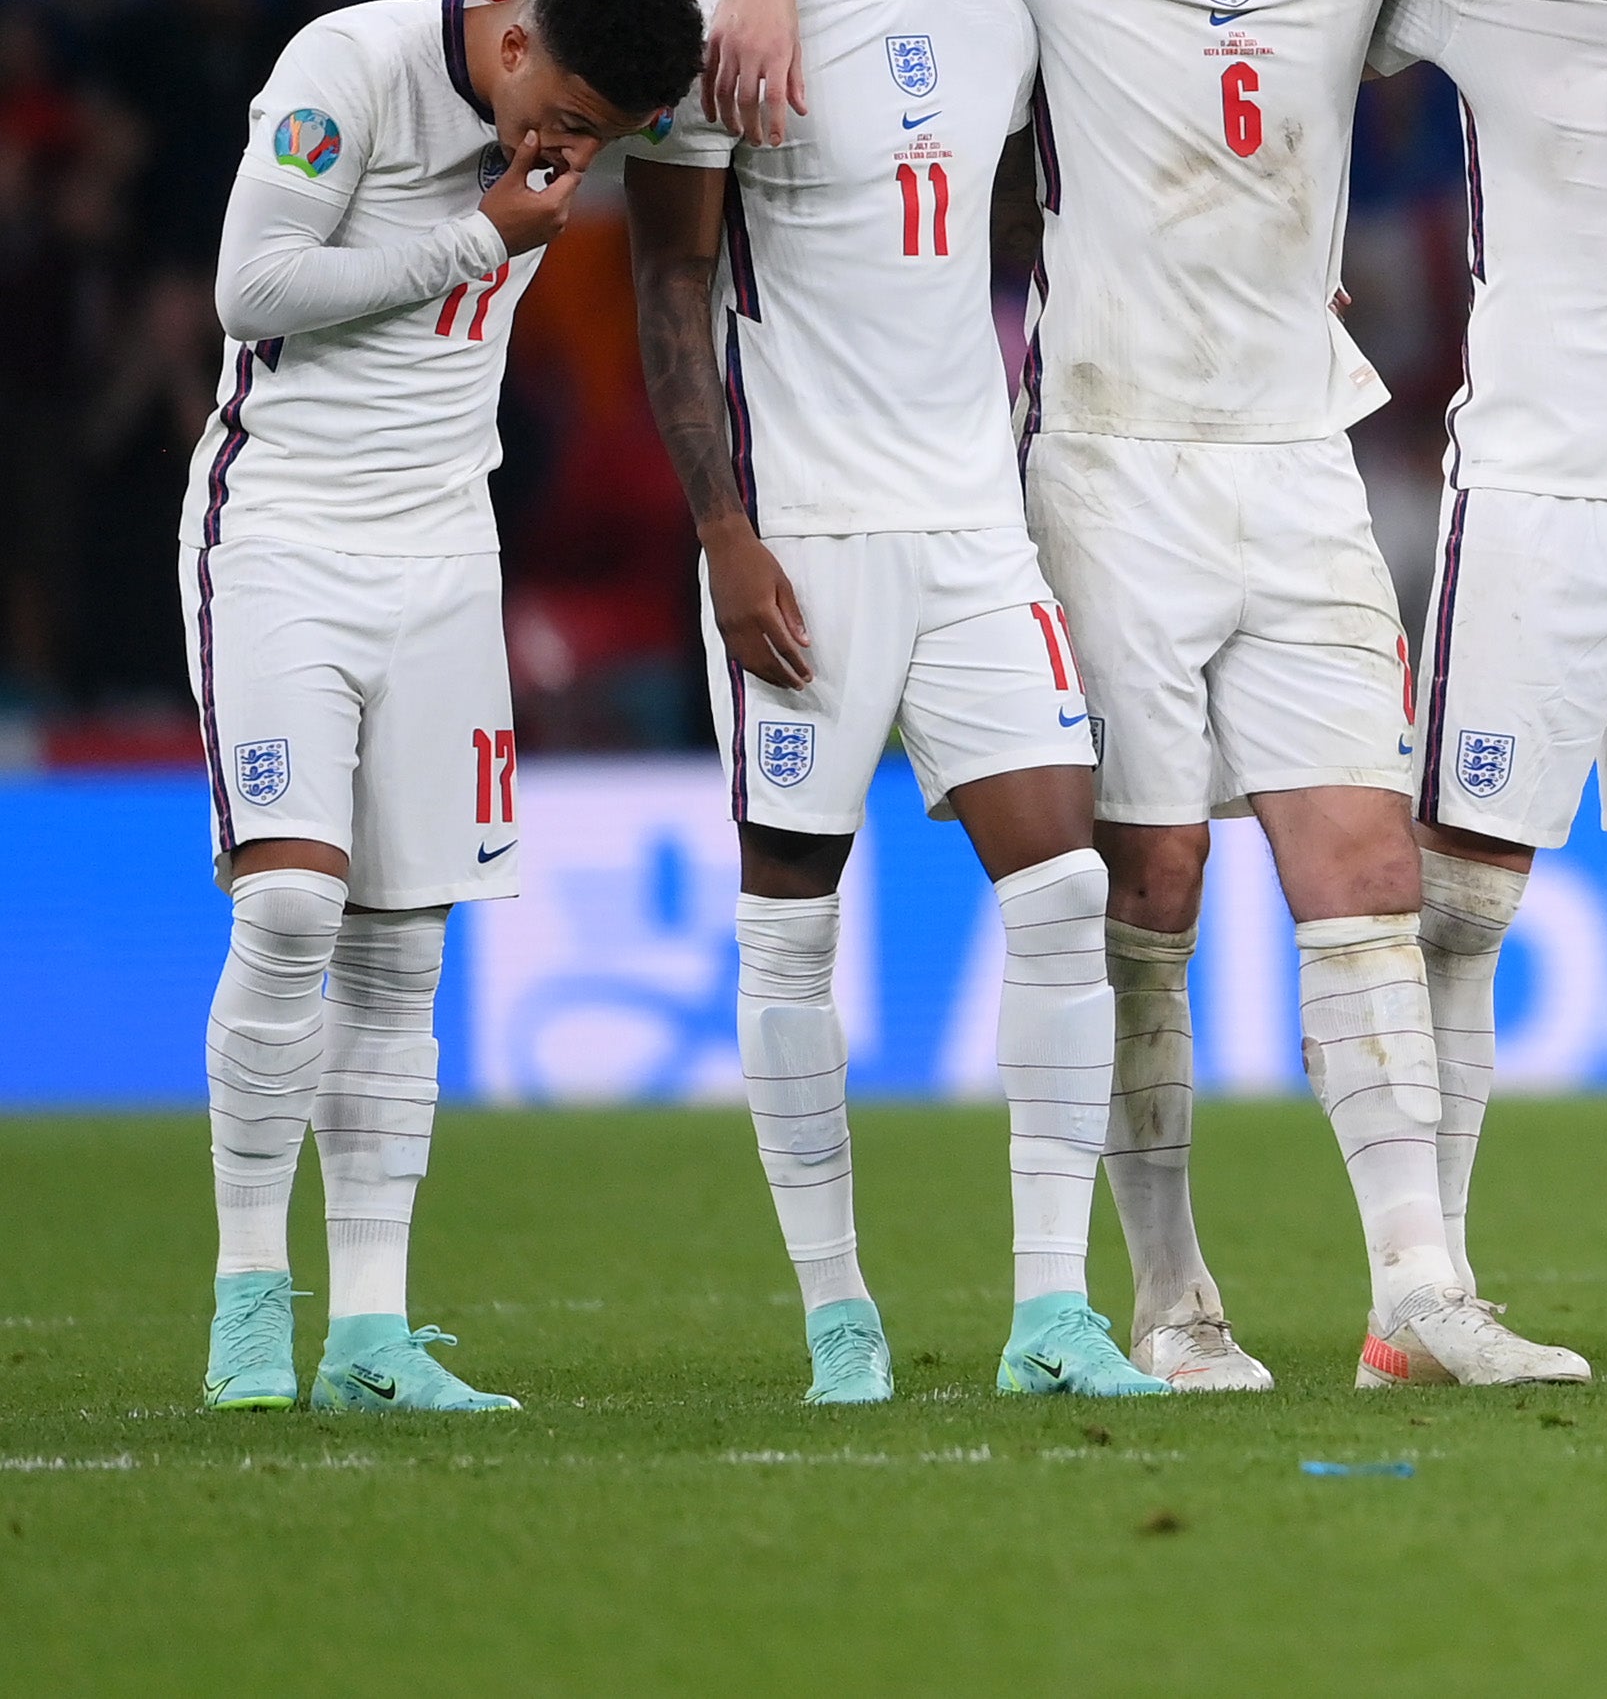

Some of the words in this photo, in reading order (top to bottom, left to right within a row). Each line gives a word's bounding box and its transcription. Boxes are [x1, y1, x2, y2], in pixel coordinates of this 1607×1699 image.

[1222, 61, 1264, 158] 6
[897, 163, 950, 257] 11
[474, 729, 516, 824] 17
